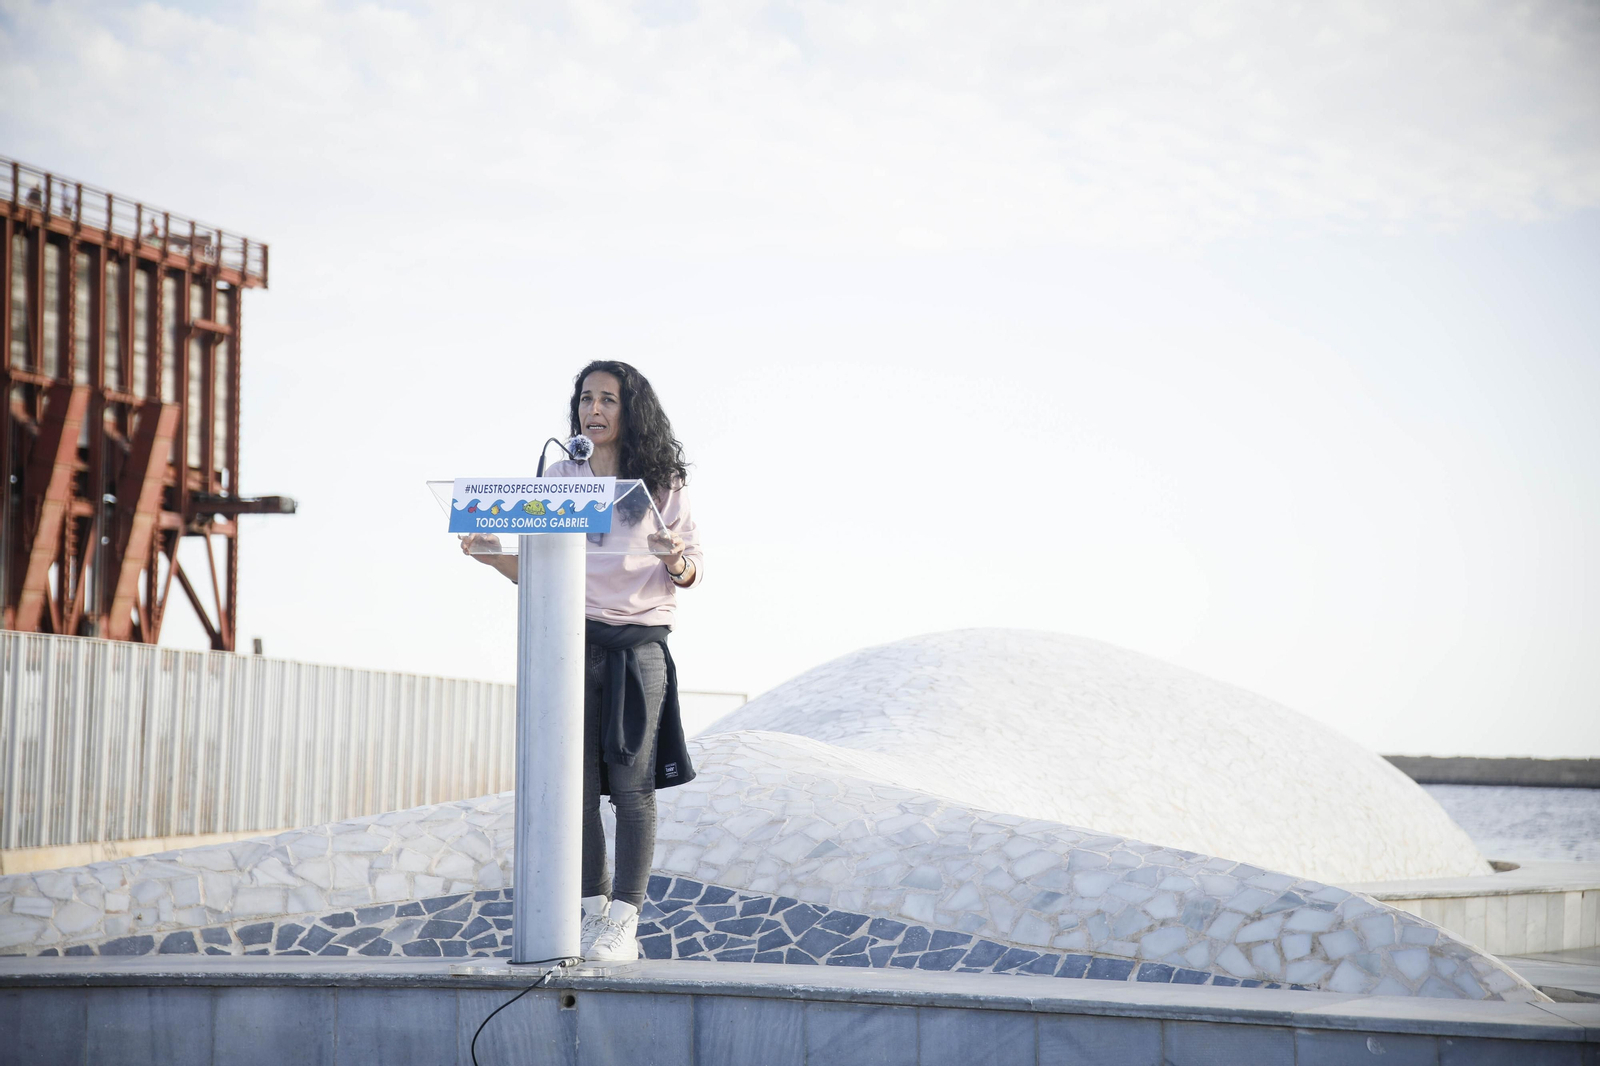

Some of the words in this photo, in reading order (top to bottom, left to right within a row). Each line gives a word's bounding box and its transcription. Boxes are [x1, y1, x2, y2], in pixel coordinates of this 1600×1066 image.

[465, 484, 605, 494] #NUESTROSPECESNOSEVENDEN
[475, 518, 509, 528] TODOS
[511, 518, 547, 528] SOMOS
[550, 517, 589, 528] GABRIEL
